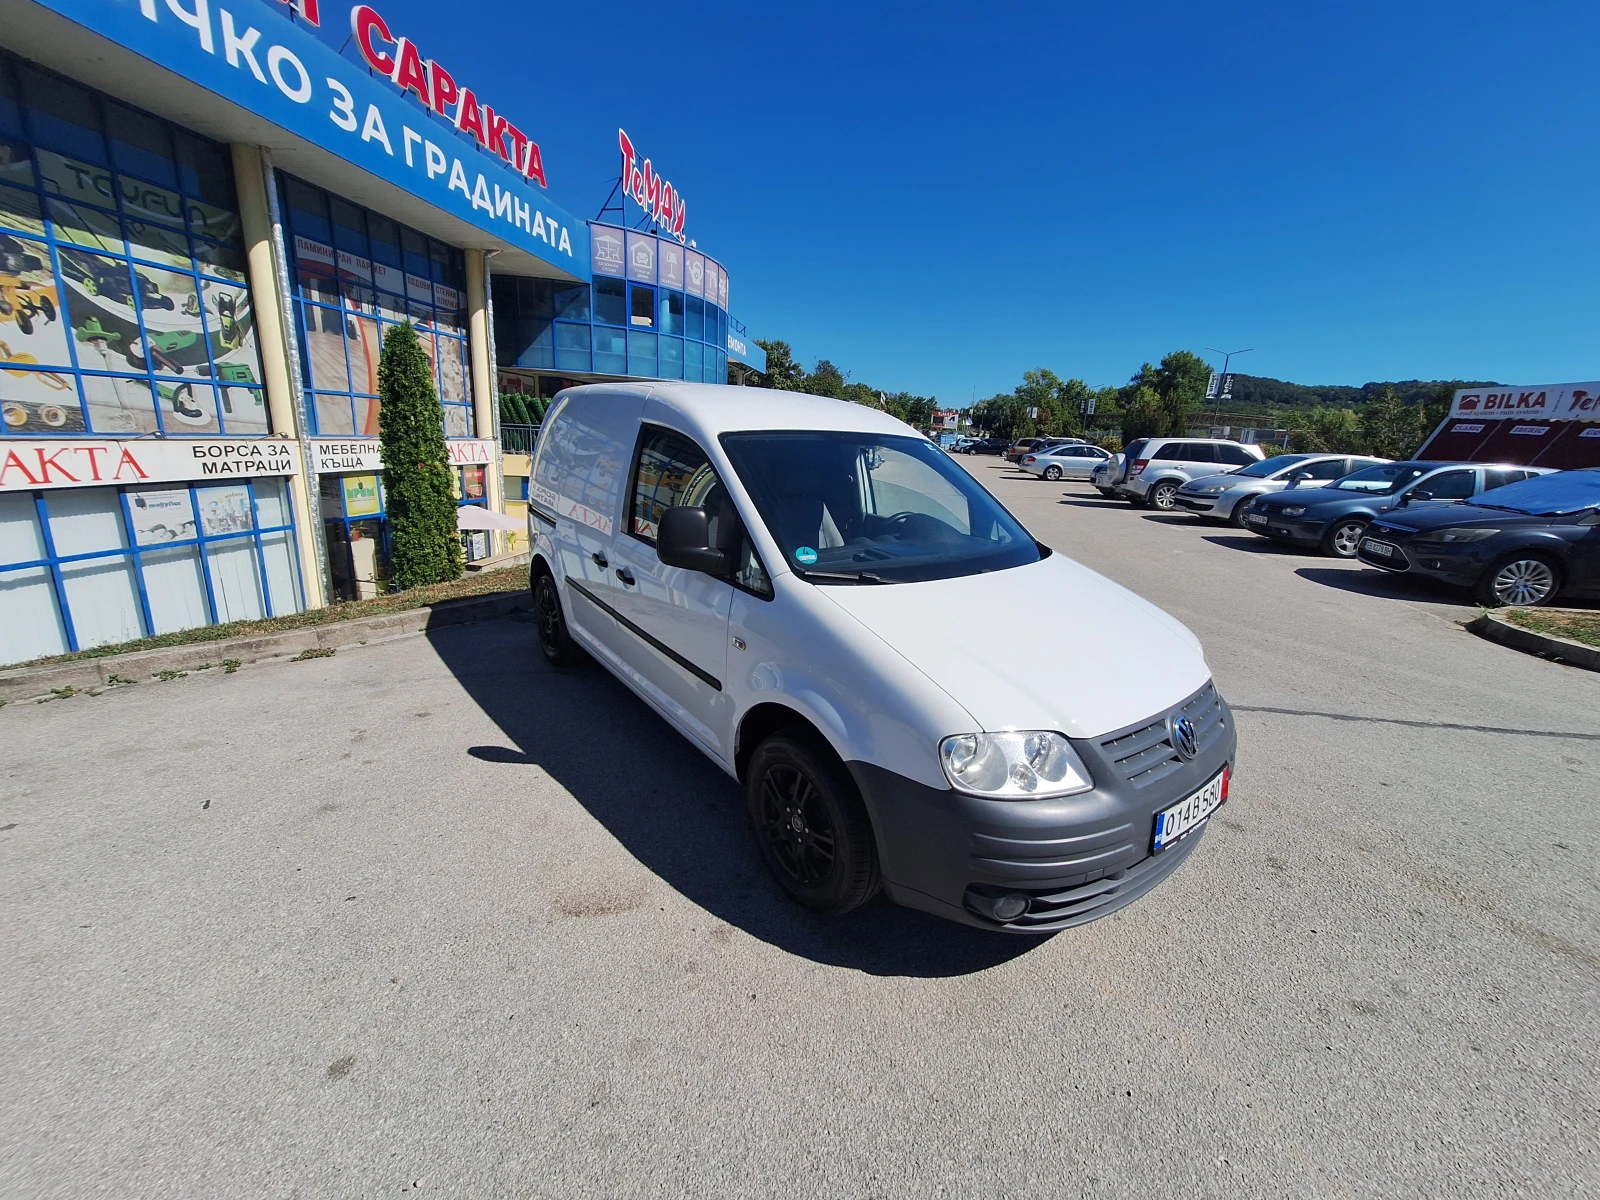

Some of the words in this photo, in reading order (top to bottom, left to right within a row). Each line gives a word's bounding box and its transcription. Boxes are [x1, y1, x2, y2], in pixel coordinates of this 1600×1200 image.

[351, 5, 547, 188] САРАКТА
[138, 0, 312, 103] ЧКО
[326, 77, 394, 156] ЗА
[402, 125, 573, 257] ГРАДИНАТА
[356, 257, 387, 276] ПАРКЕТ
[1483, 391, 1546, 409] BILKA
[192, 444, 263, 459] БОРСА
[268, 444, 290, 456] ЗА
[319, 444, 382, 455] МЕБЕЛНА
[0, 447, 149, 486] АКТА
[202, 459, 292, 474] МАТРАЦИ
[321, 457, 364, 469] КЪЩА
